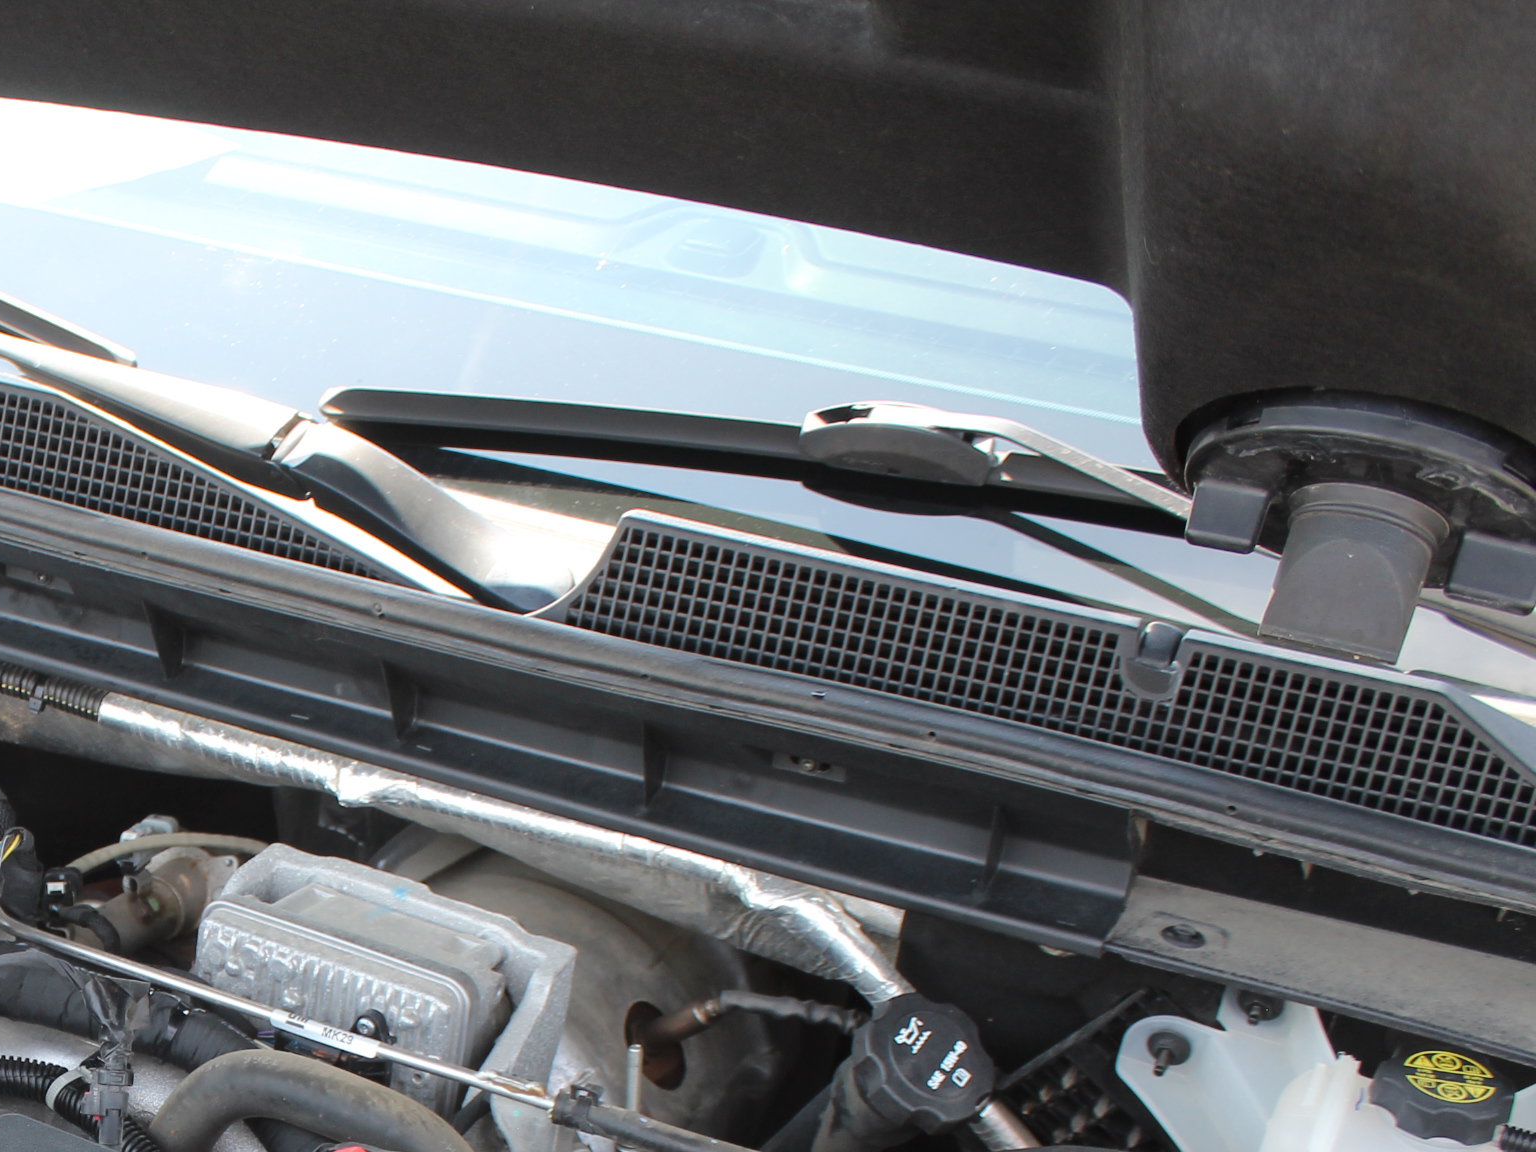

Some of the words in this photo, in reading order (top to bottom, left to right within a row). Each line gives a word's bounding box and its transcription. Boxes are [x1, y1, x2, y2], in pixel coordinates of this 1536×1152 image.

[321, 1026, 354, 1045] MK29
[927, 1070, 946, 1090] SAE
[940, 1040, 968, 1072] 15W-40
